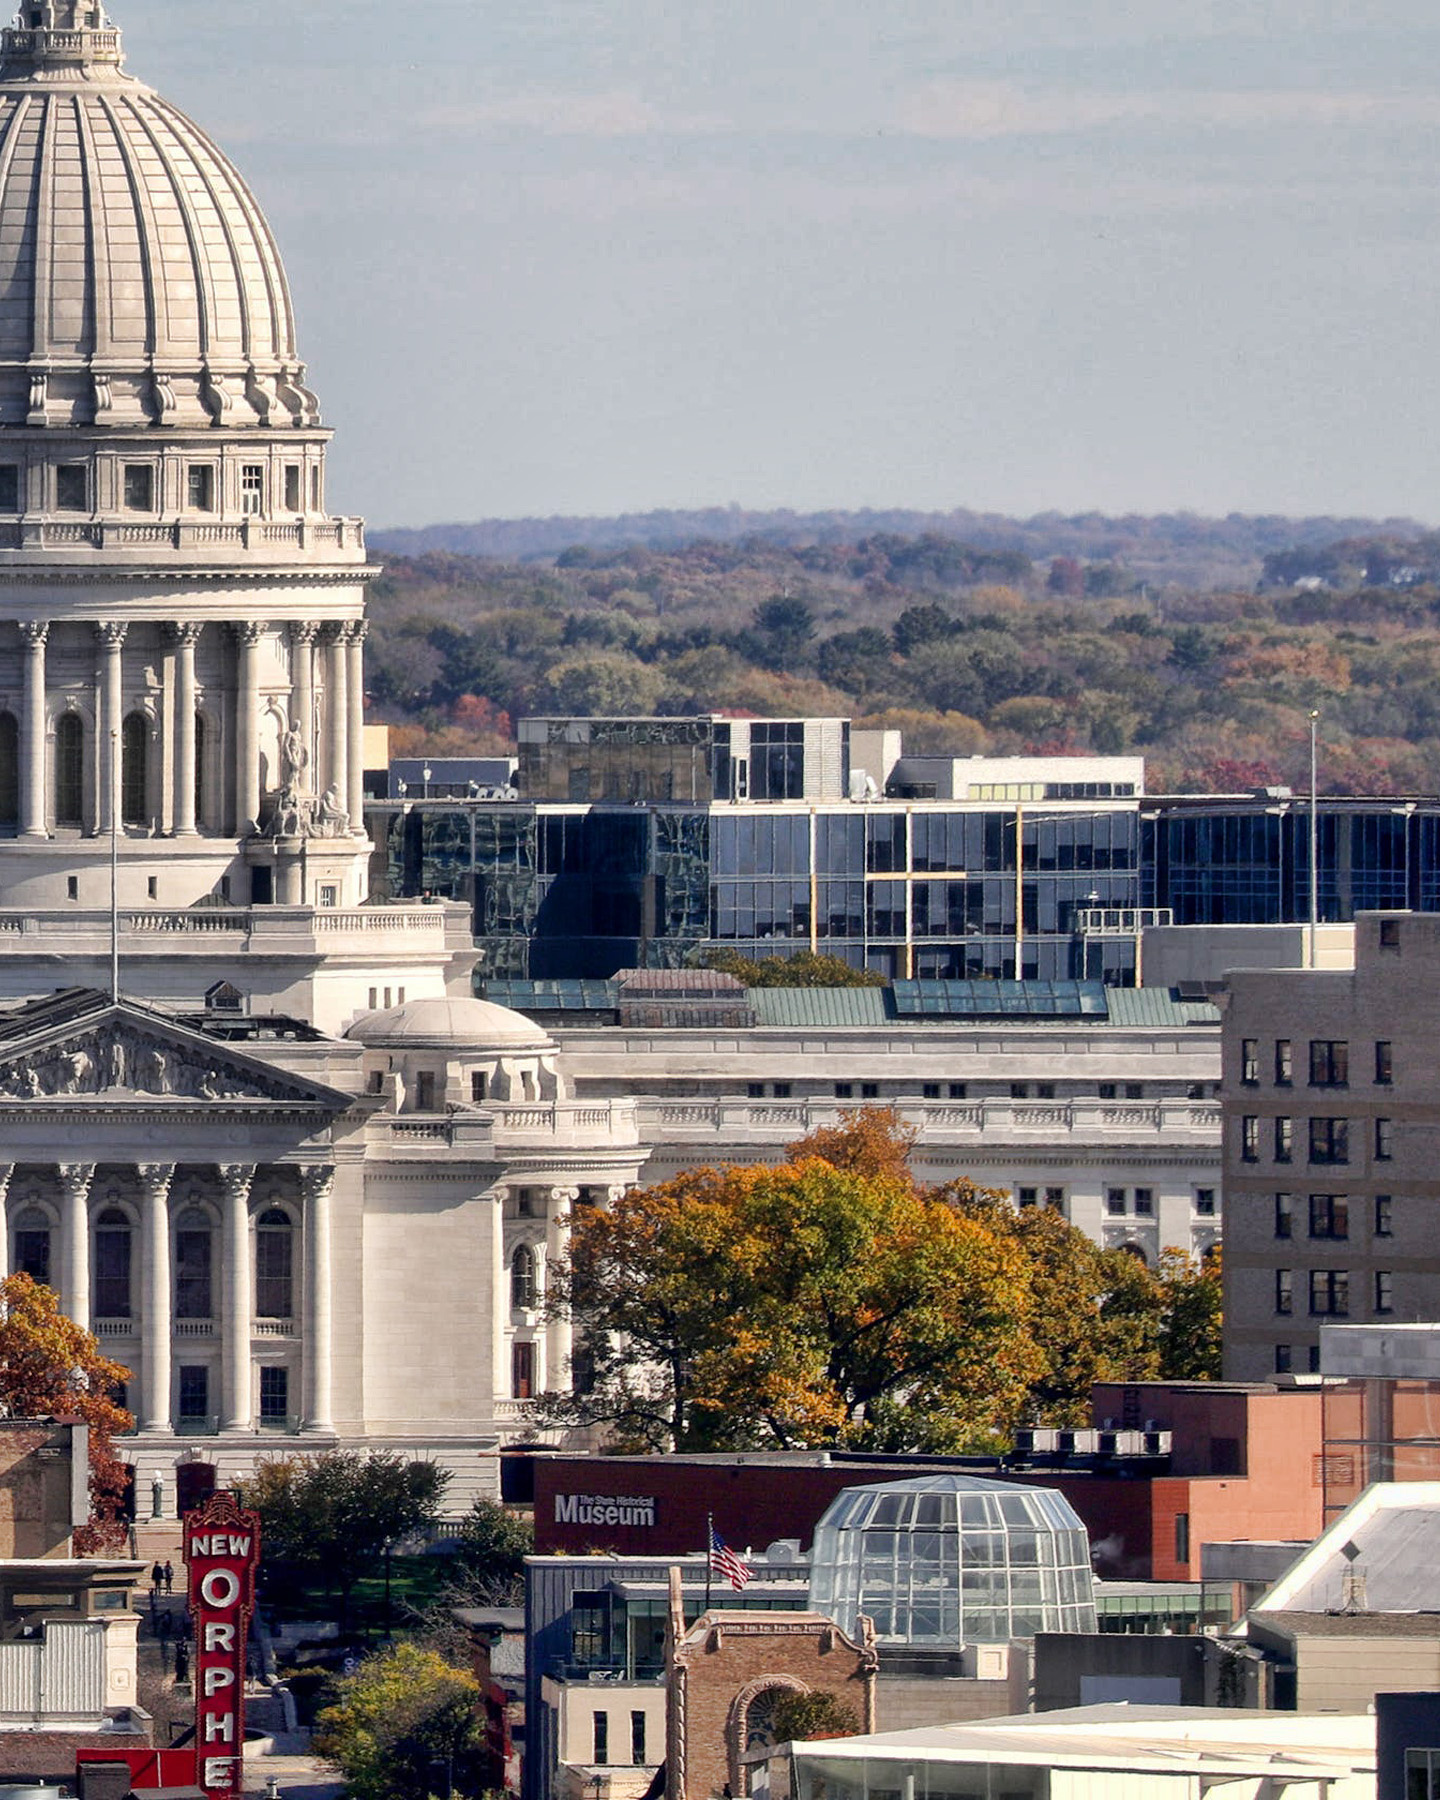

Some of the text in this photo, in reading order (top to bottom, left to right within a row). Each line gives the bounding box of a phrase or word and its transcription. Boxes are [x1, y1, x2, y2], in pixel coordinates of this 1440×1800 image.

[555, 1494, 655, 1526] Museum
[580, 1495, 594, 1505] The
[616, 1496, 654, 1507] Historical
[191, 1534, 251, 1558] NEW
[201, 1568, 241, 1788] ORPHE
